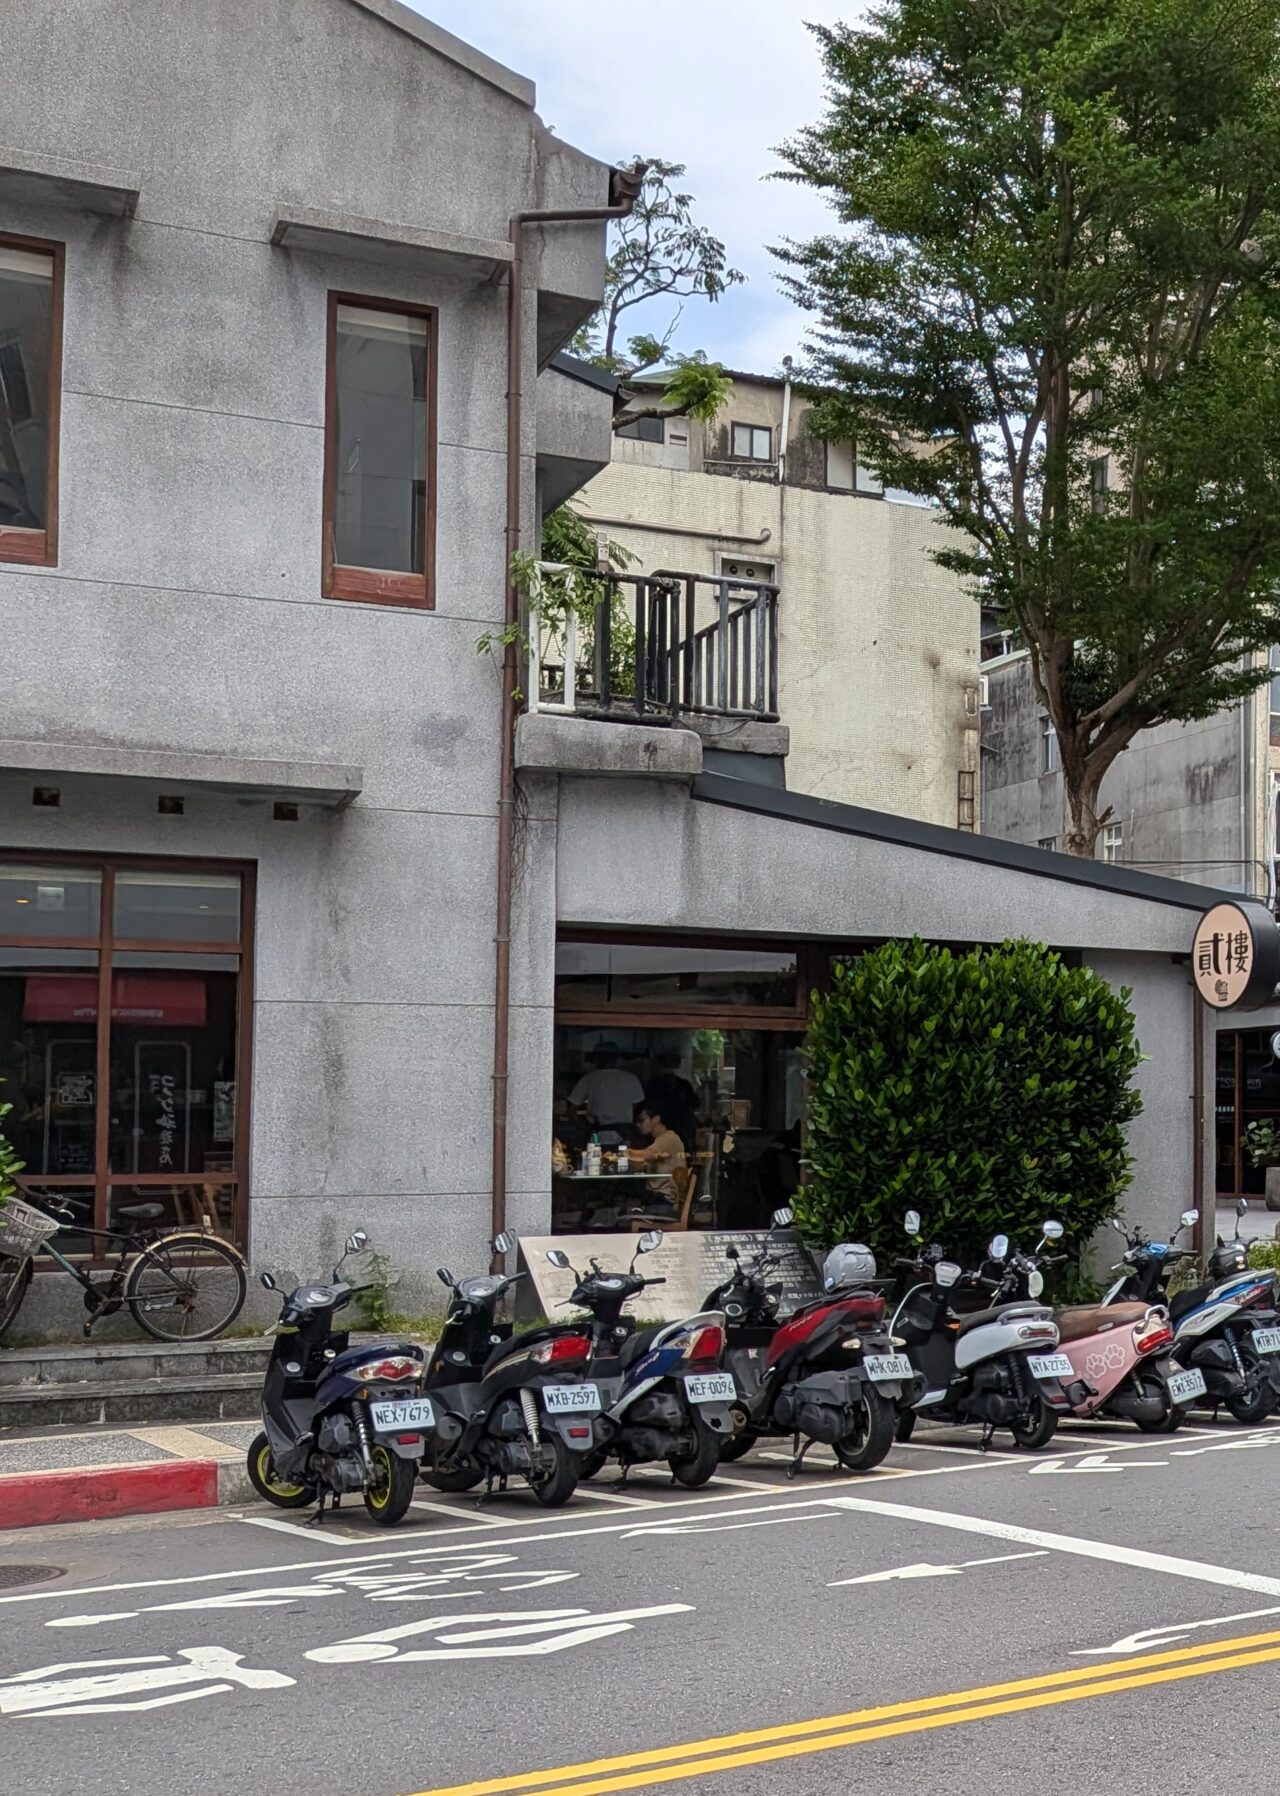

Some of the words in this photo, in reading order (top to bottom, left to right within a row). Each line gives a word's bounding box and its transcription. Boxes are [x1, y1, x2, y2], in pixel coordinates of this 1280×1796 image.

[1198, 930, 1250, 977] 貳樓
[868, 1359, 911, 1375] MHK-0816
[1031, 1359, 1071, 1374] NYA-2735
[688, 1380, 734, 1397] MEF-0096
[1171, 1376, 1204, 1397] EMX-3512
[546, 1390, 596, 1407] MXB-2597
[375, 1406, 430, 1426] NEX-7679
